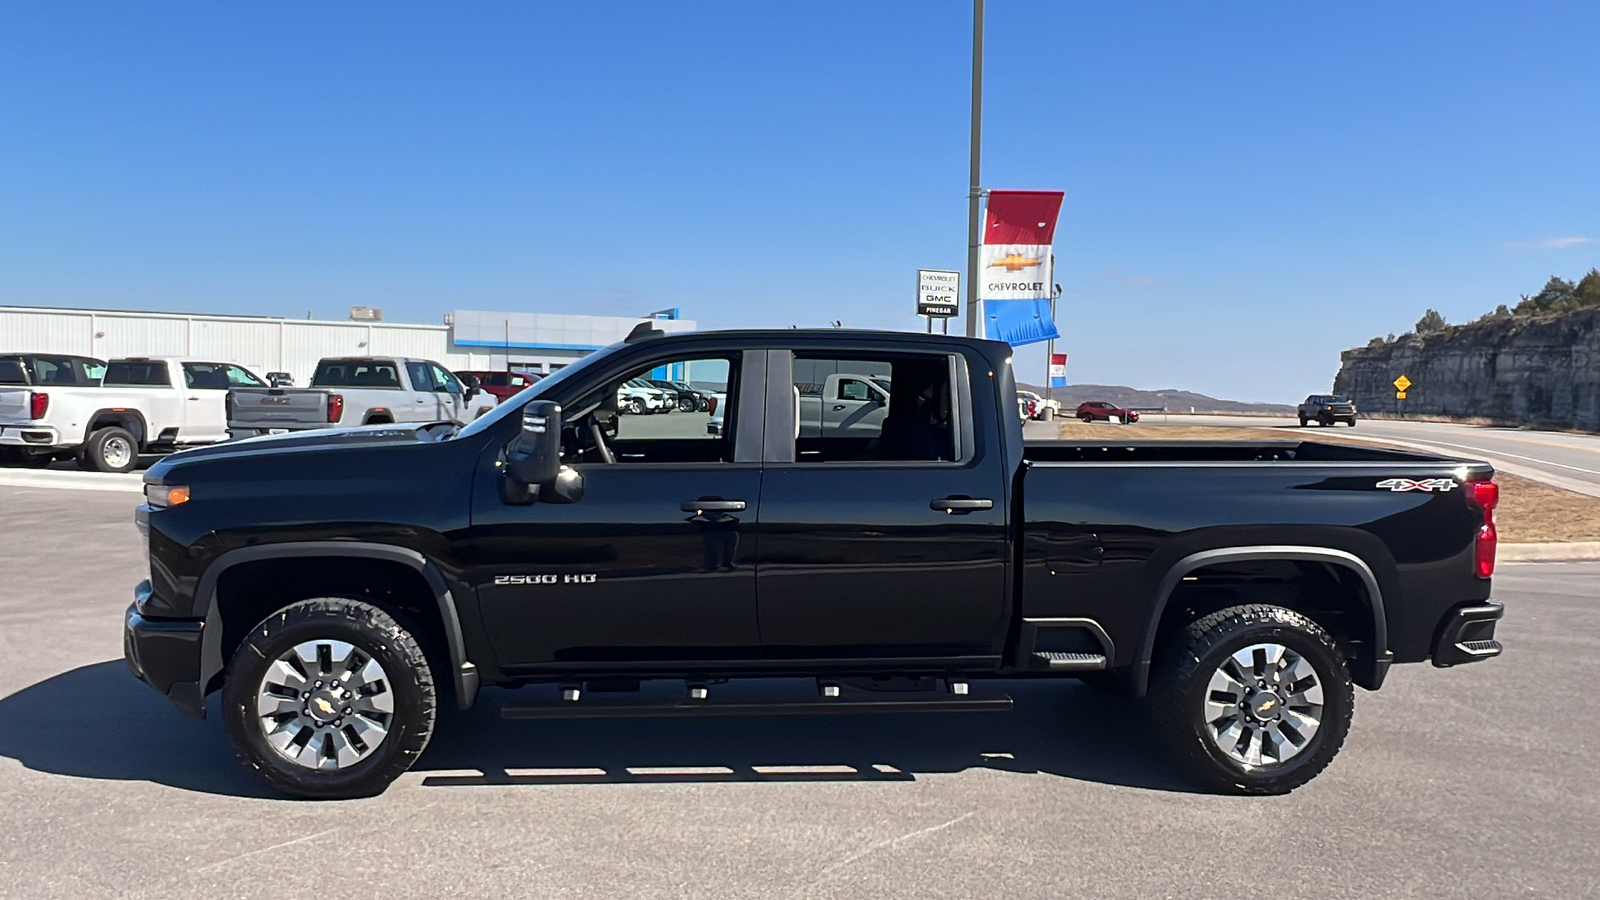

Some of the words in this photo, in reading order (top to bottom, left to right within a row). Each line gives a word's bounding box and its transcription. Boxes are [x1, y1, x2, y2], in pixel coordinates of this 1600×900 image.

[988, 282, 1044, 291] CHEVROLET
[494, 574, 558, 585] 2500
[564, 573, 597, 583] HD
